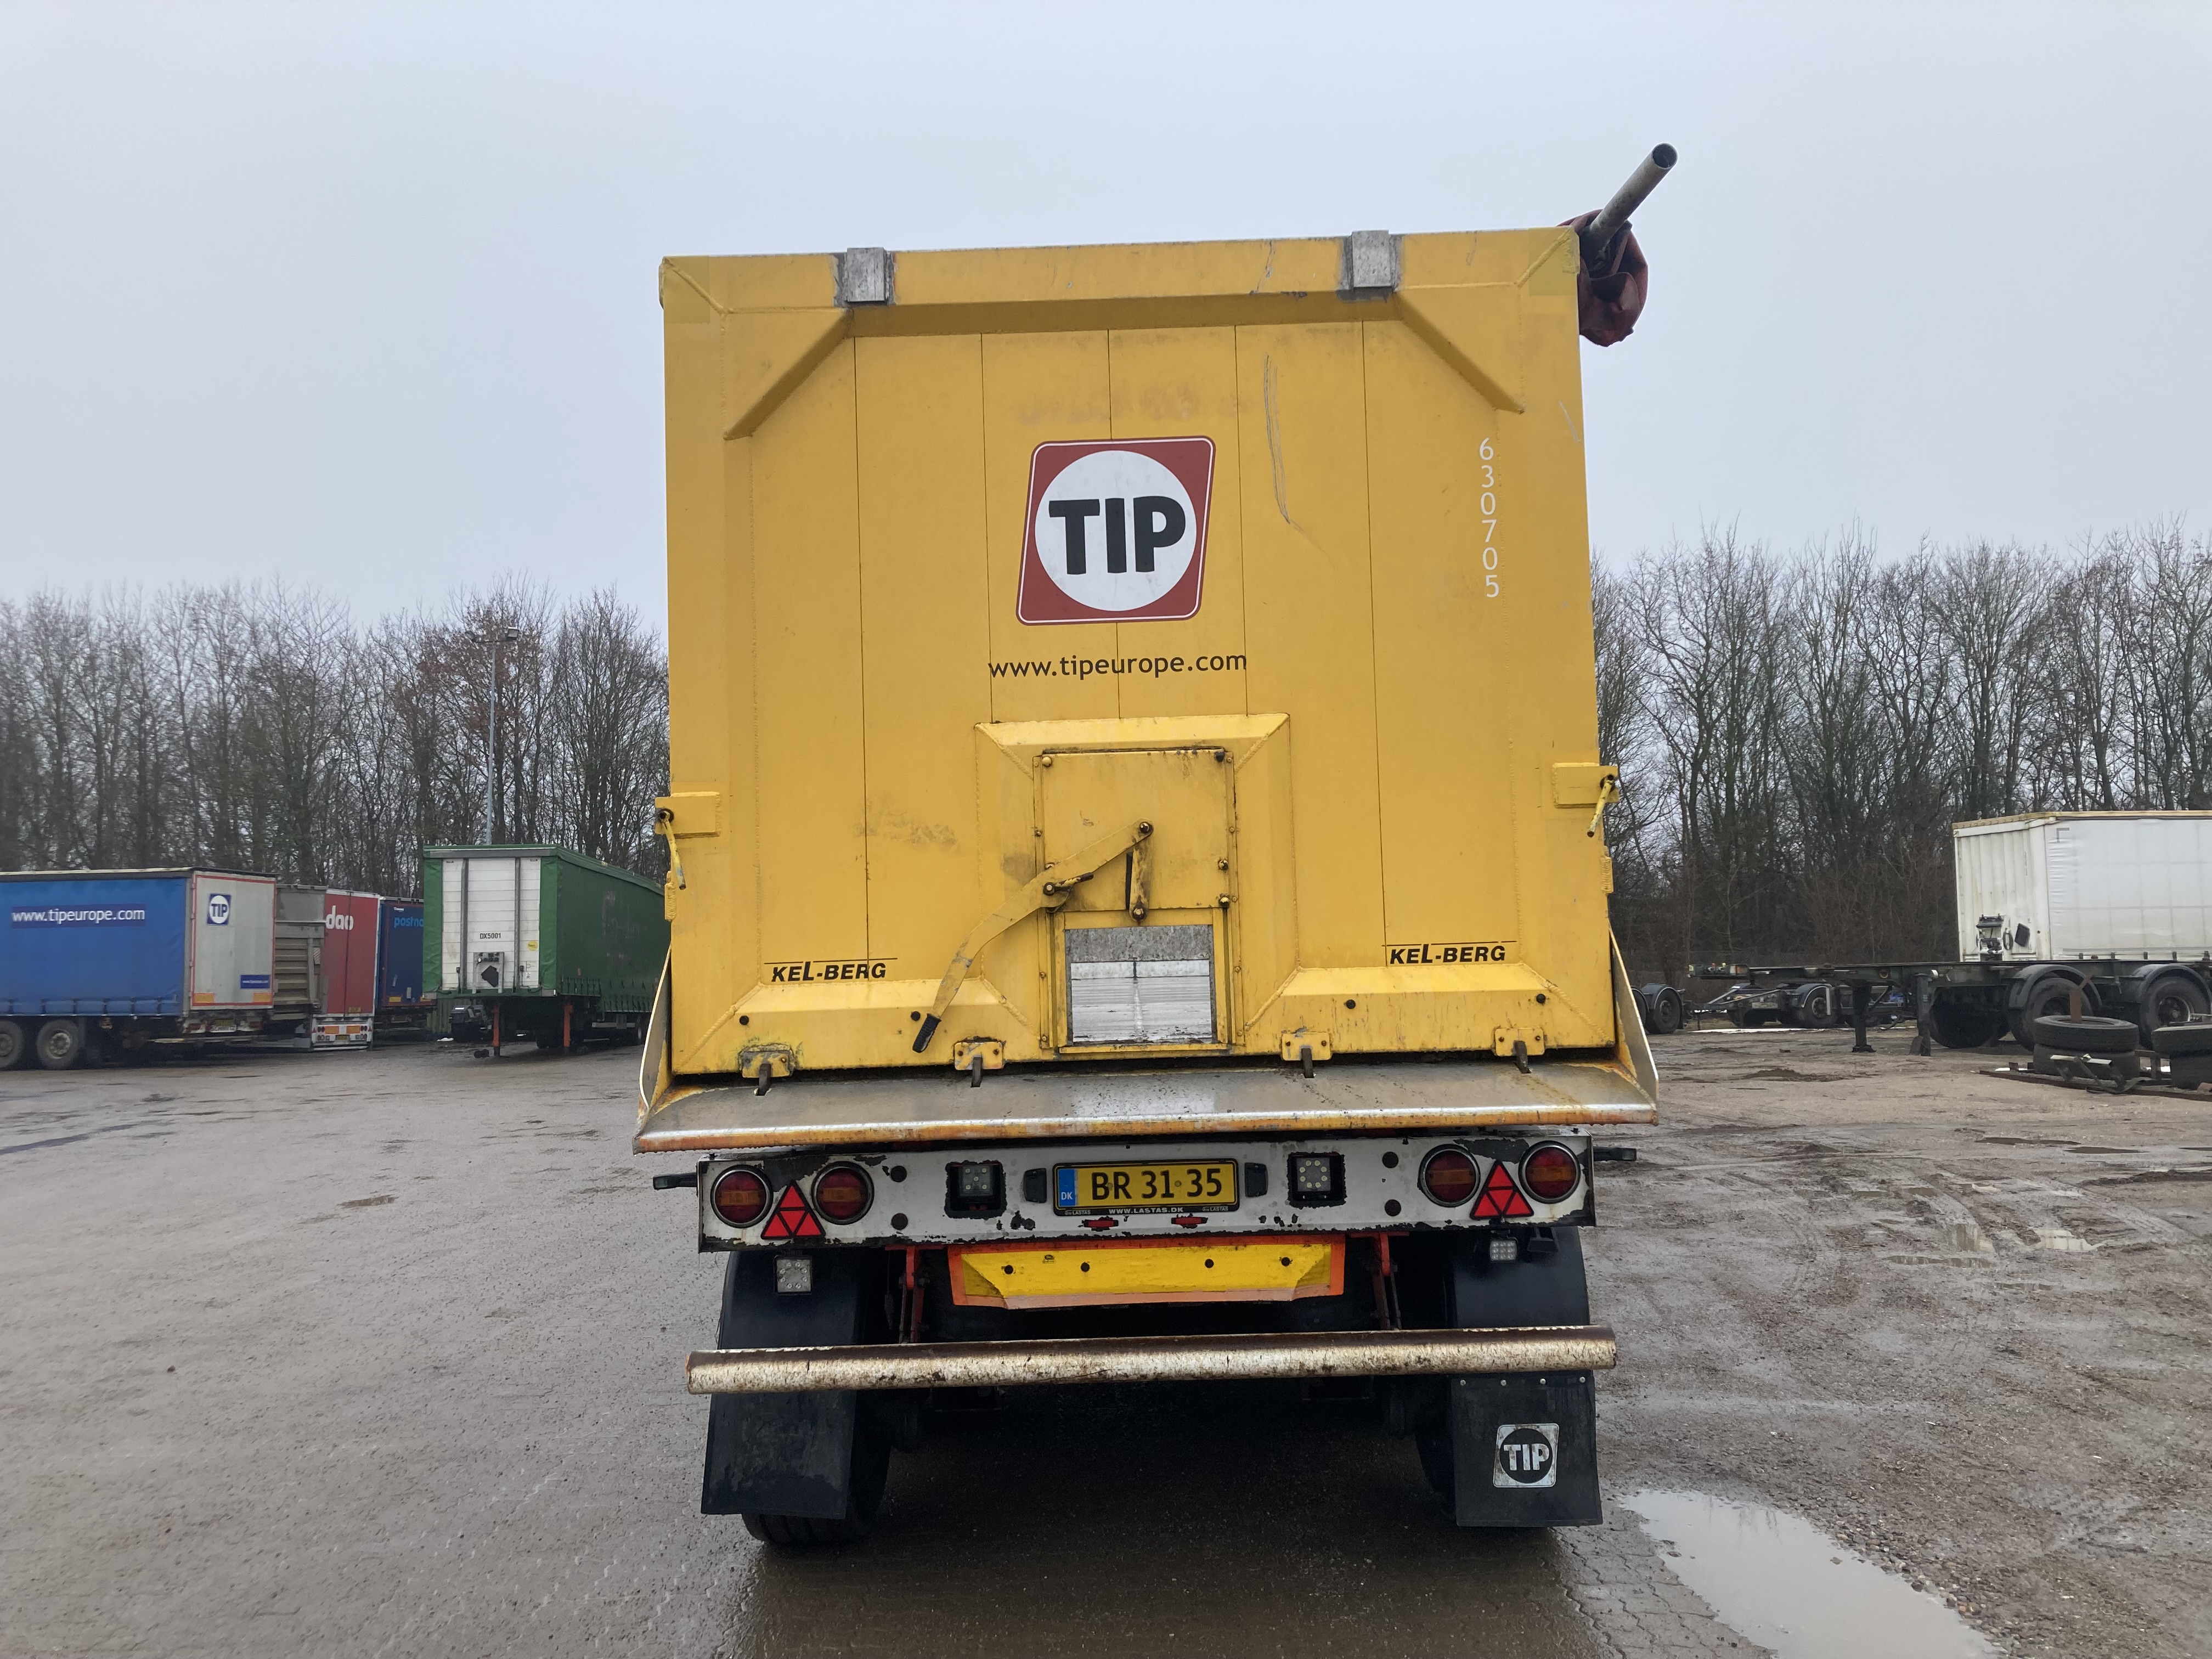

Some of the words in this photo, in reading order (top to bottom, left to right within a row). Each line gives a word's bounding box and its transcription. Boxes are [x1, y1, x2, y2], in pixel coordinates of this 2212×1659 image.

[1479, 437, 1499, 598] 630705
[1048, 495, 1186, 575] TIP
[988, 654, 1247, 680] www.tipeurope.com
[12, 909, 145, 924] www.tipeurope.com
[211, 904, 227, 917] TIP
[326, 905, 354, 930] dao
[1390, 944, 1505, 964] KEL-BERG
[771, 961, 887, 983] KEL-BERG
[1061, 1192, 1073, 1200] DK
[1092, 1171, 1132, 1200] BR
[1141, 1170, 1175, 1199] 31
[1186, 1168, 1222, 1197] 35
[1503, 1443, 1550, 1471] TIP
